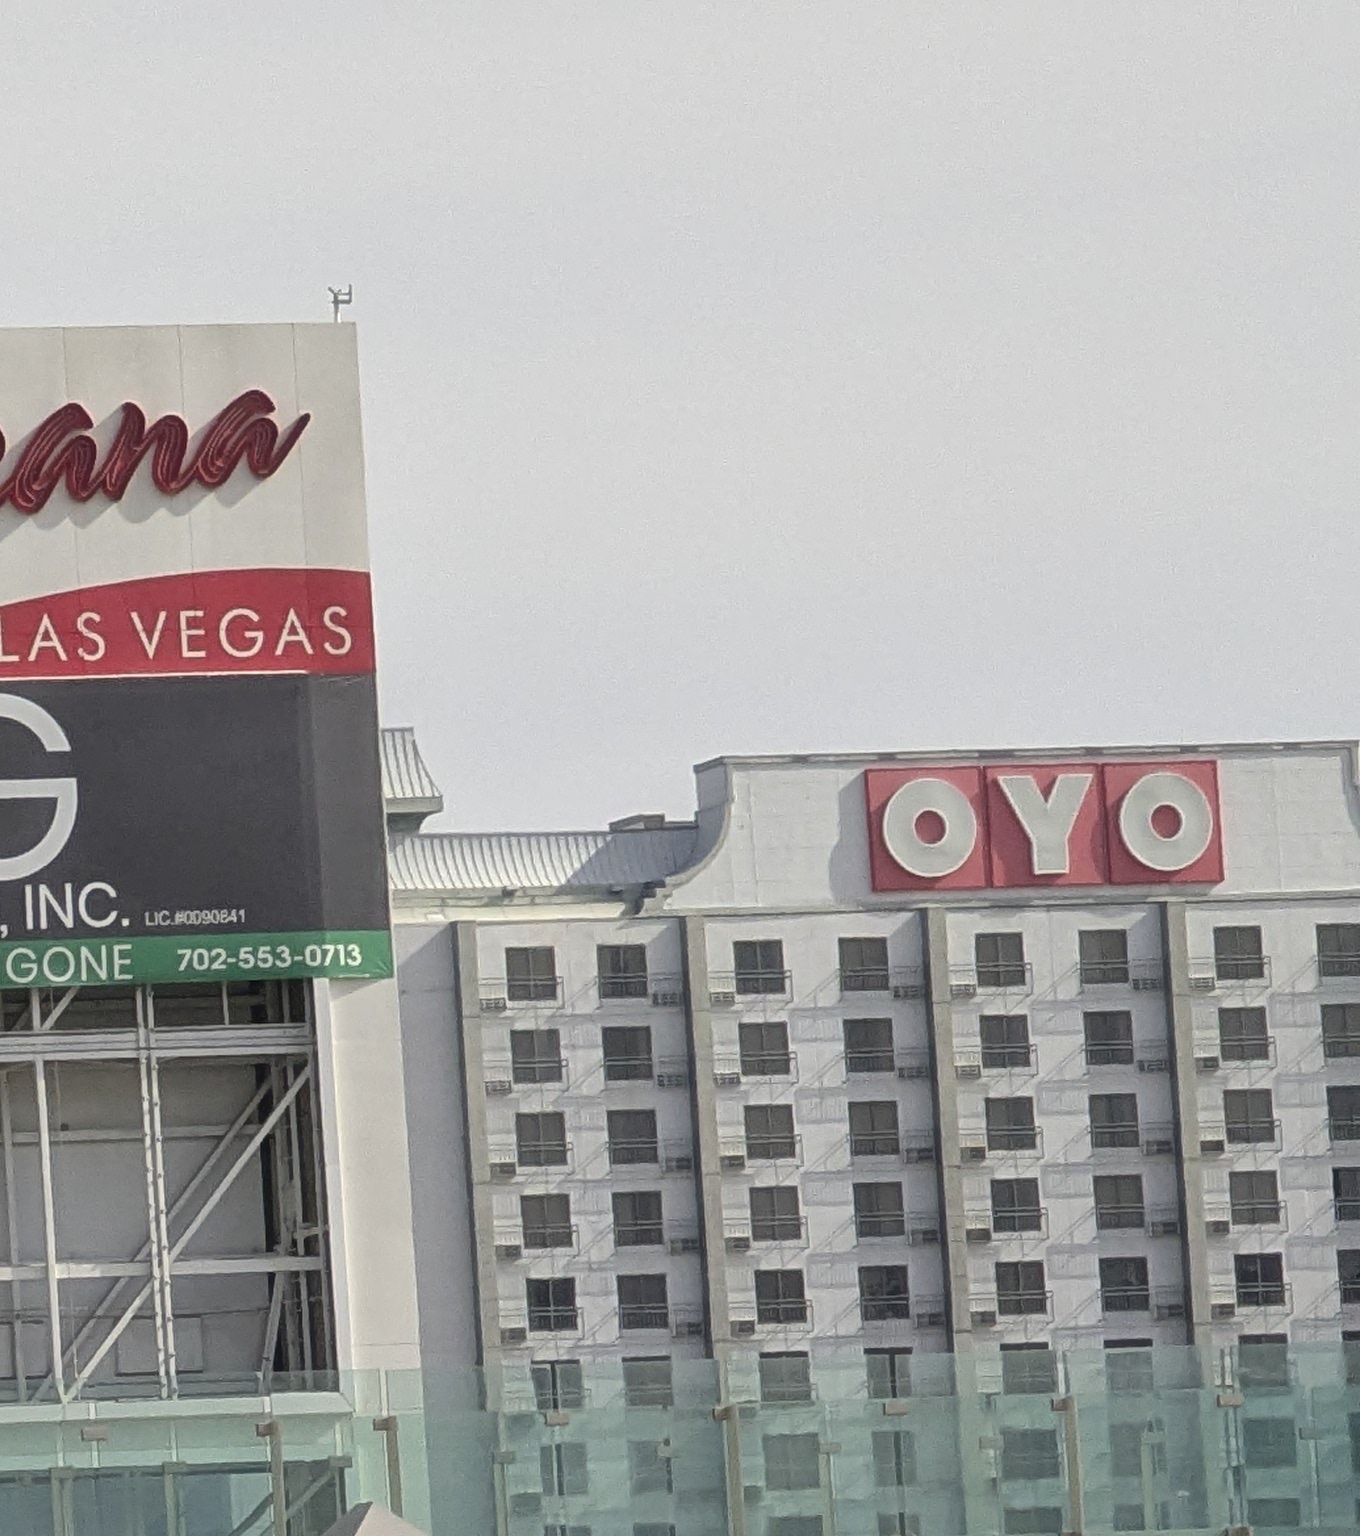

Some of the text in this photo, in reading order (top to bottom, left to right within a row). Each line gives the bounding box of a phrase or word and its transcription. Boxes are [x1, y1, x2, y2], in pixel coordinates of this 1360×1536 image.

[129, 605, 353, 660] VEGAS
[883, 771, 1213, 878] OYO
[25, 881, 130, 931] INC.
[177, 943, 363, 972] 702-553-0713
